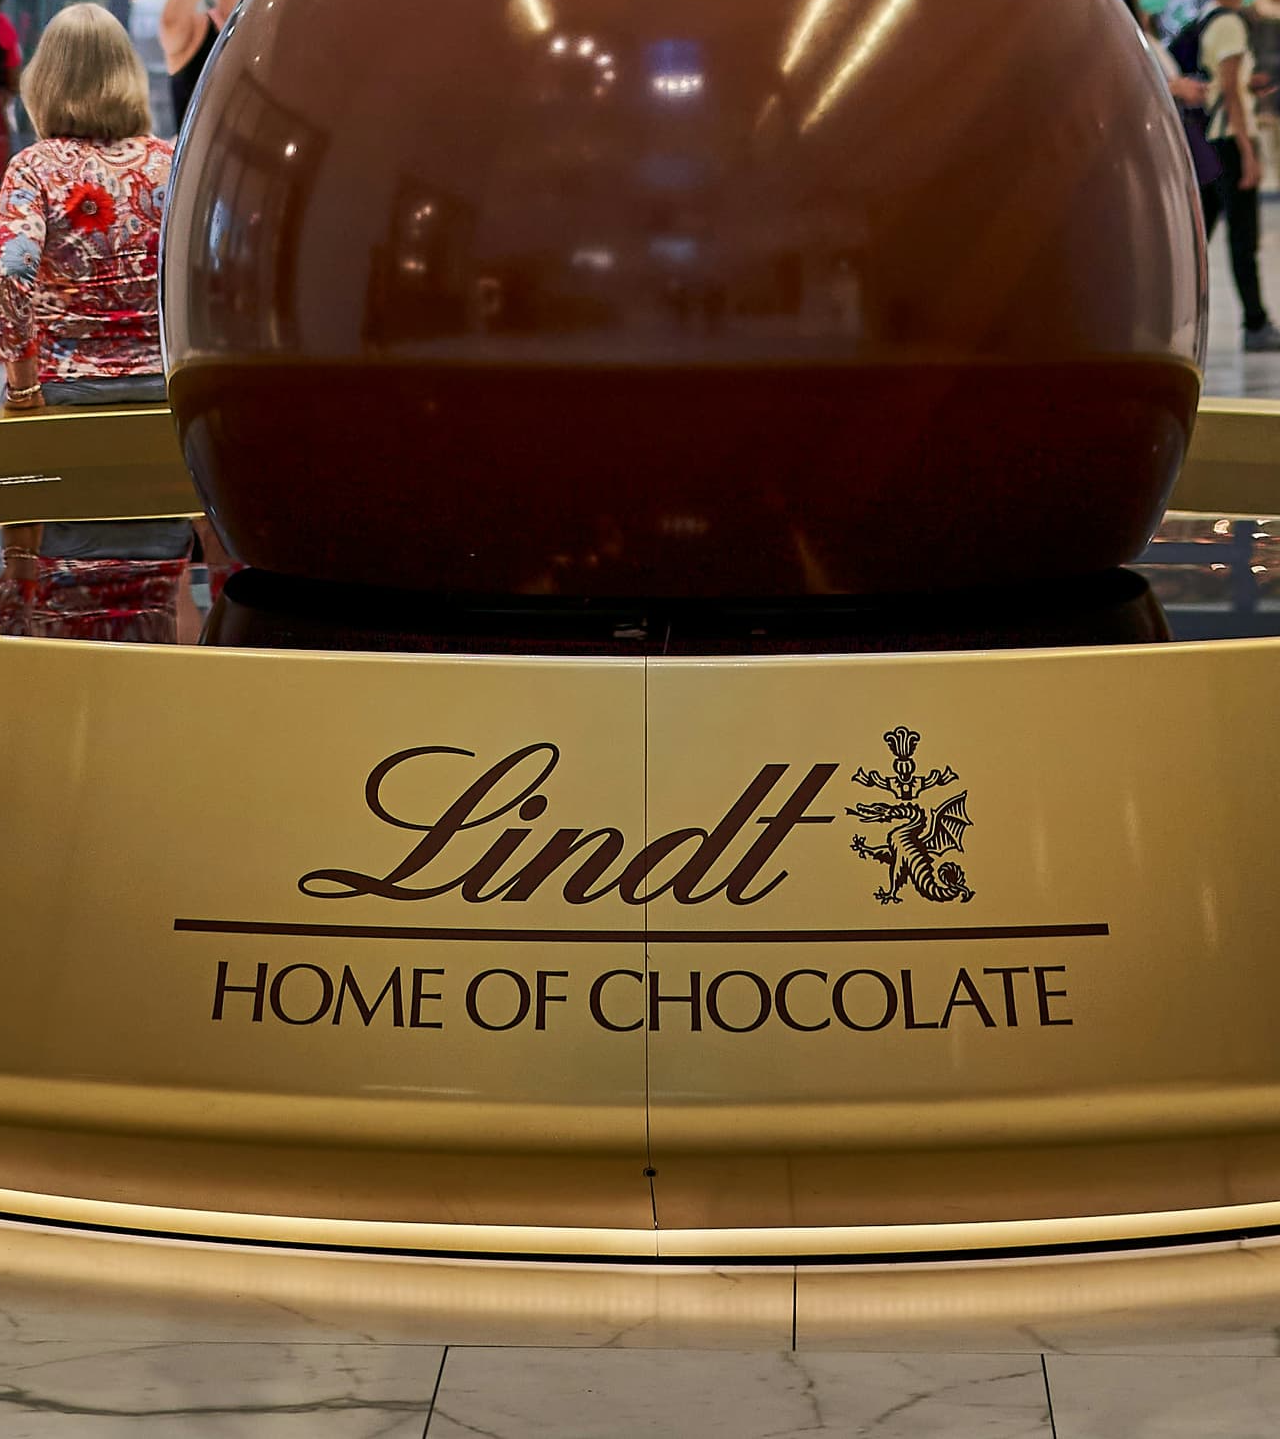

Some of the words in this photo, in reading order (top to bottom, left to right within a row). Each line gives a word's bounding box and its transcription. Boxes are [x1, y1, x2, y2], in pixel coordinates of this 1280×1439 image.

[298, 742, 840, 906] Lindt
[210, 960, 445, 1030] HOME
[465, 968, 569, 1033] OF
[588, 964, 1074, 1034] CHOCOLATE
